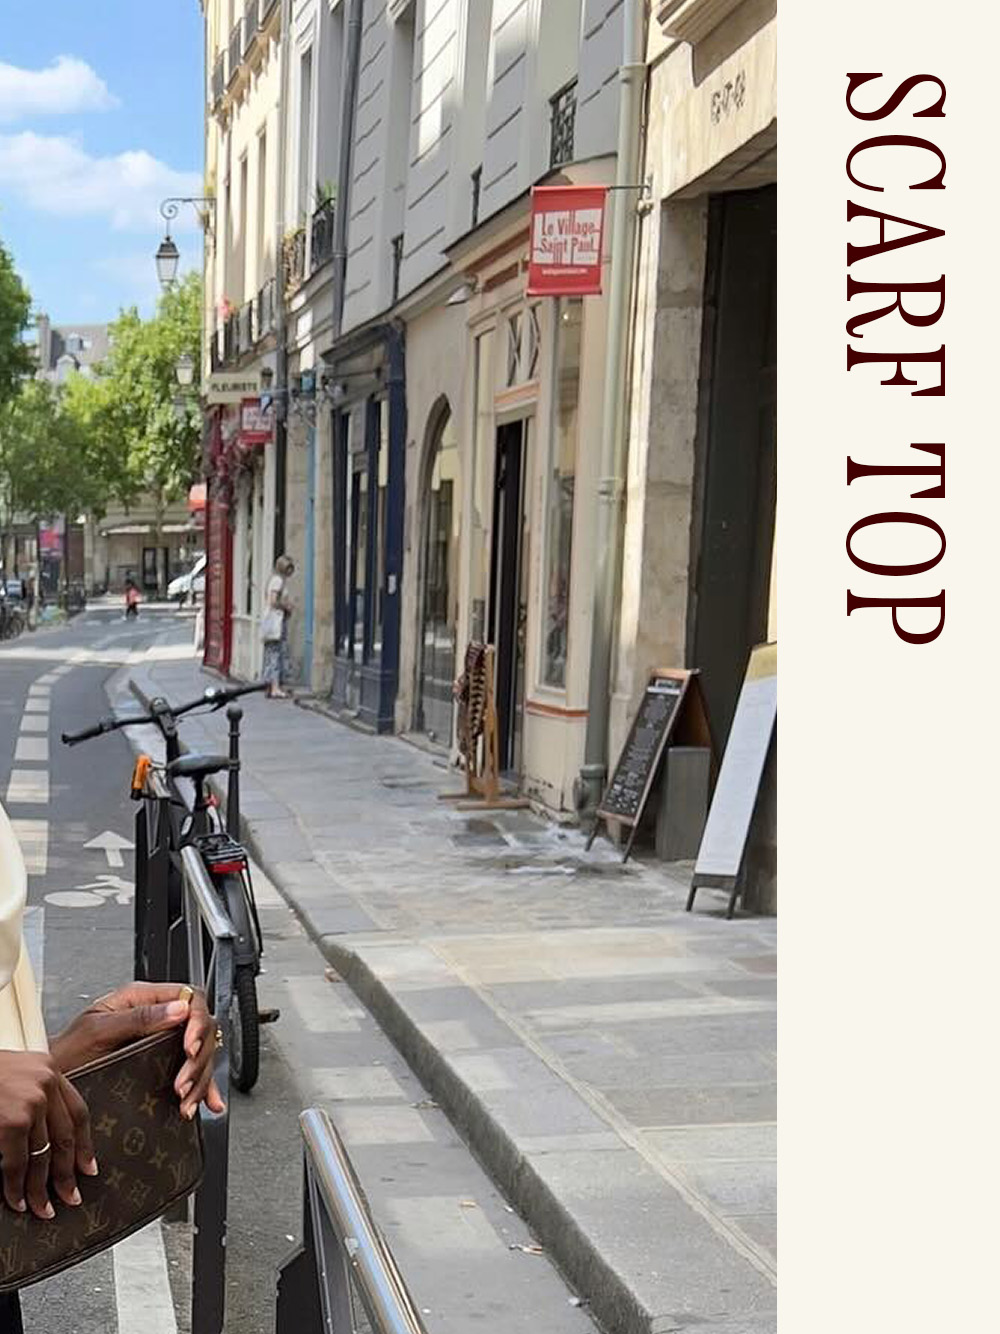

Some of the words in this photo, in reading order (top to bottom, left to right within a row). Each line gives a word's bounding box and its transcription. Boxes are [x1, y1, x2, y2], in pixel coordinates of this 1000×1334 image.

[541, 214, 555, 236] Le
[557, 216, 596, 237] Village
[539, 237, 568, 254] Saint
[571, 236, 595, 253] Paul
